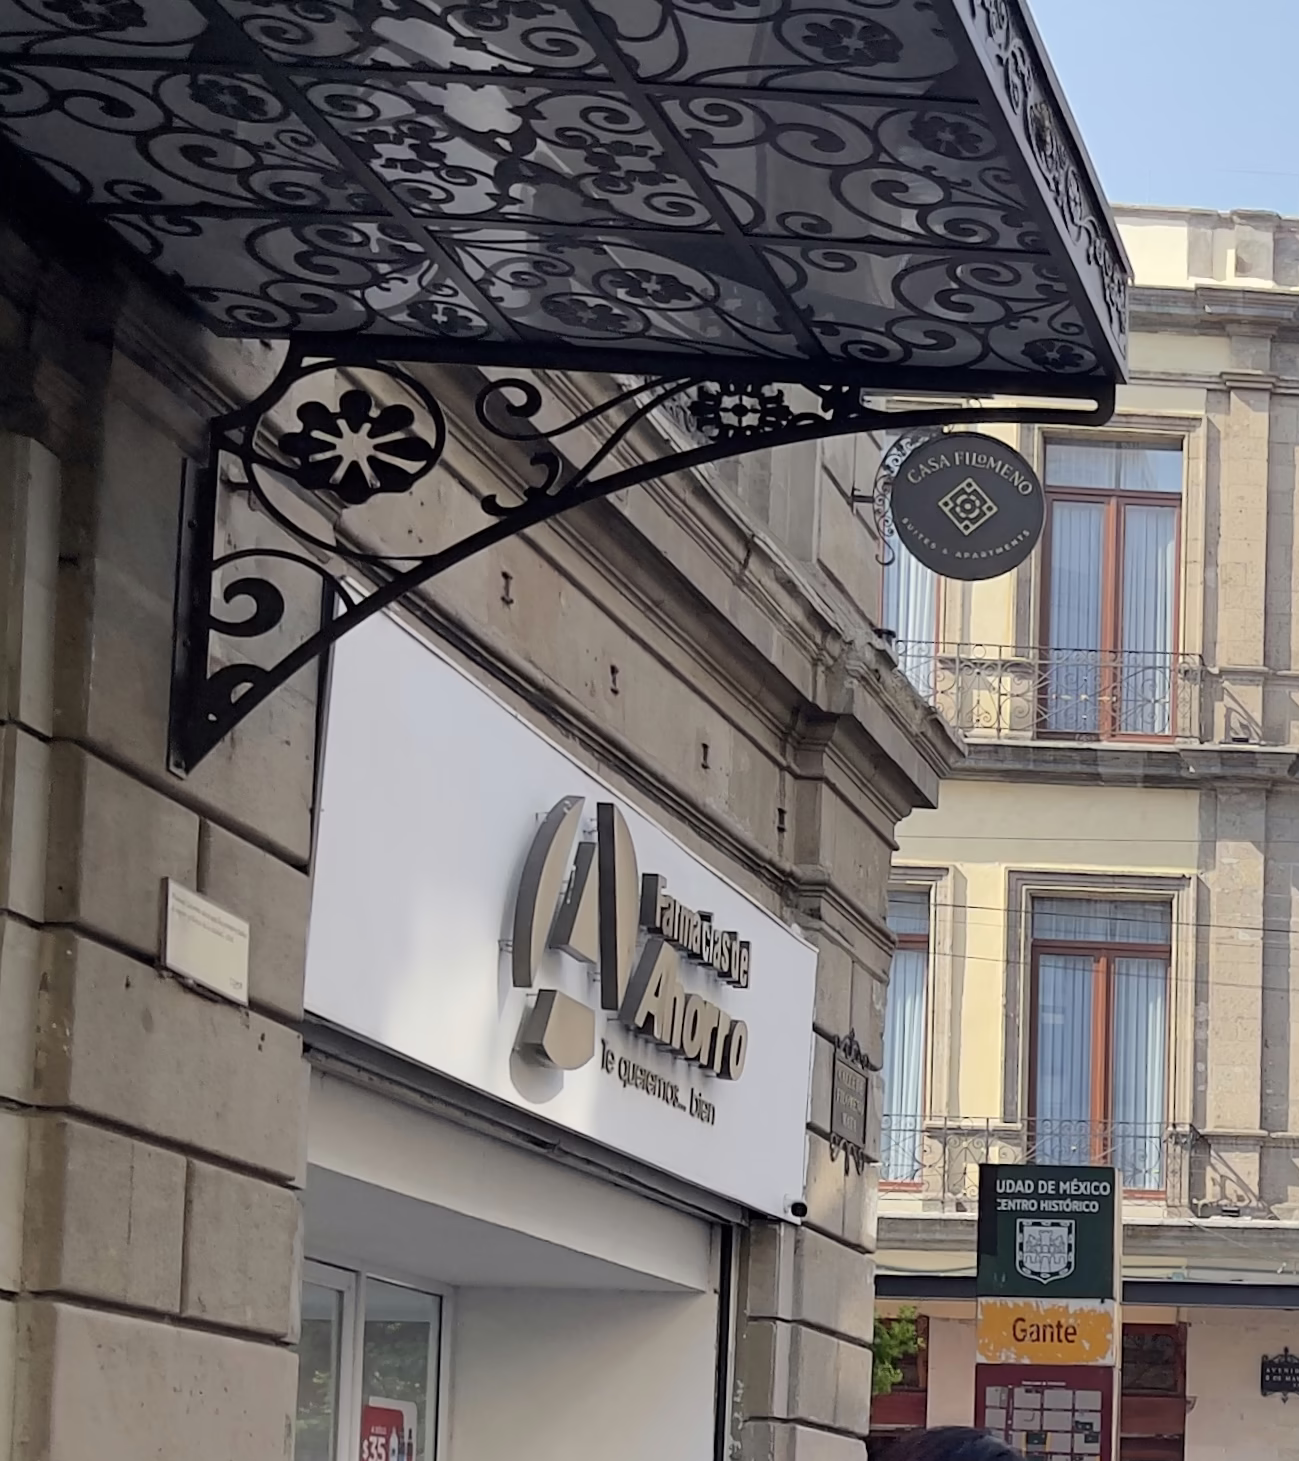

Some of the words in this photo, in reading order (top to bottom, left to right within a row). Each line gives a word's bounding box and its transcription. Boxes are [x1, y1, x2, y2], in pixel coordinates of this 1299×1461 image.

[907, 454, 951, 483] CASA
[954, 451, 1033, 495] FILOMENO
[902, 517, 937, 549] SUITES
[955, 529, 1030, 559] APARTMENTS
[640, 872, 731, 976] Farmacias
[618, 938, 748, 1081] Ahorro
[690, 1087, 715, 1125] bien
[996, 1179, 1035, 1194] UDAD
[1038, 1180, 1055, 1194] DE
[1059, 1177, 1111, 1196] MÉXICO
[1040, 1198, 1099, 1213] HISTÓRICO
[1012, 1317, 1077, 1343] Gante
